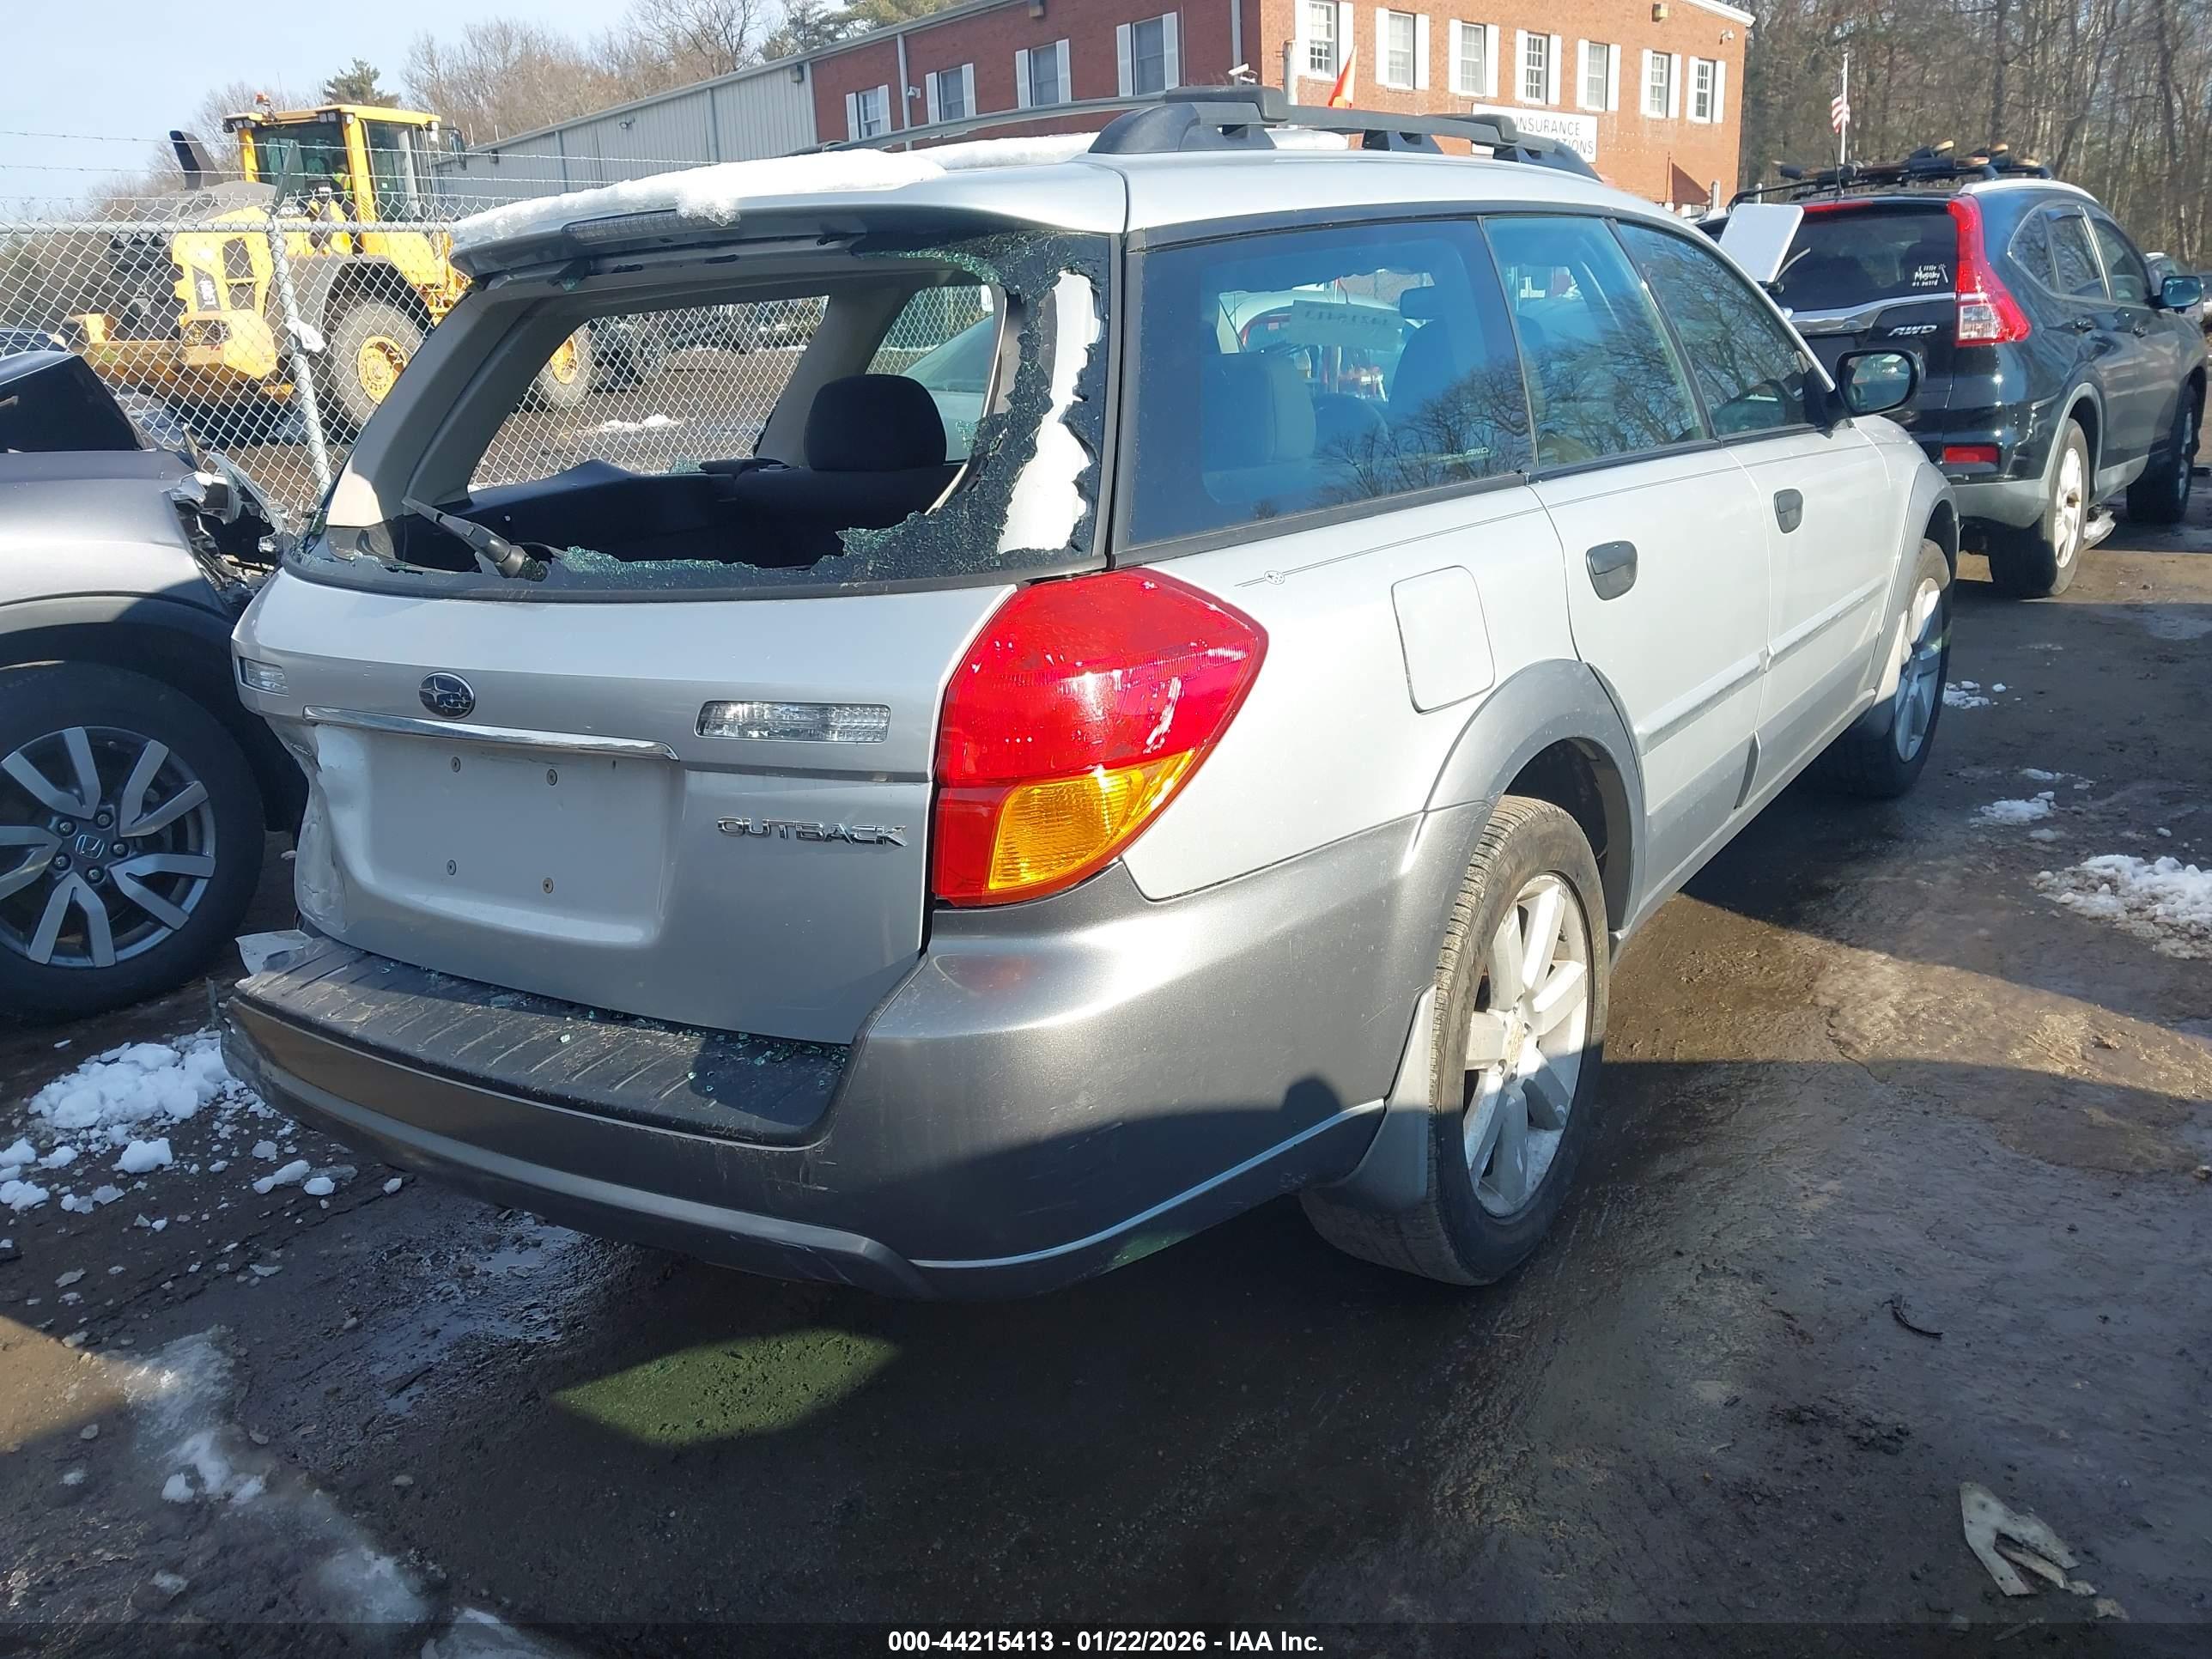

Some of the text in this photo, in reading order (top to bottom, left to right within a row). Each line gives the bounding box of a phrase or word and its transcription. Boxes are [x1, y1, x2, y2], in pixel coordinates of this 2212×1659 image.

[1516, 116, 1580, 136] INSURANCE
[1887, 325, 1938, 337] AWD
[717, 816, 908, 847] OUTBACK
